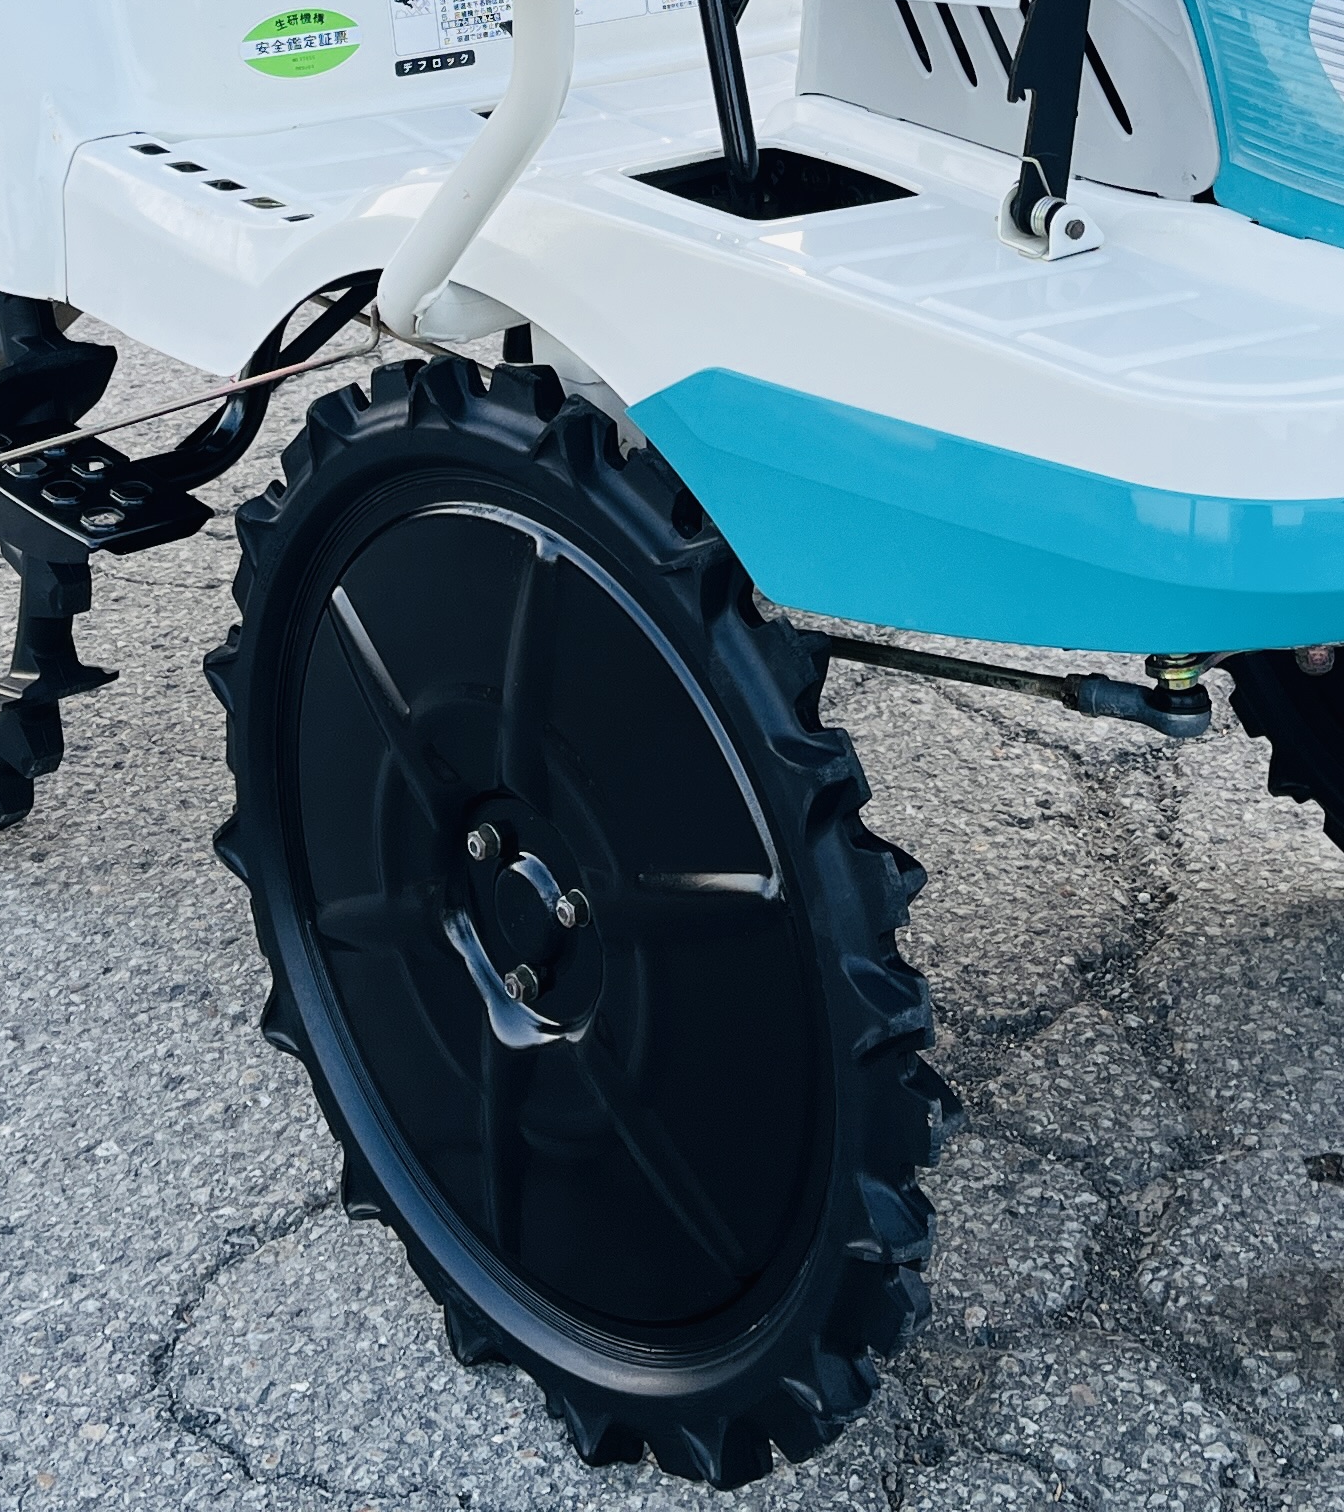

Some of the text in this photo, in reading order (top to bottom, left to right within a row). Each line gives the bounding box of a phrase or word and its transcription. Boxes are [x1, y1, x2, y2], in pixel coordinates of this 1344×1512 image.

[275, 12, 325, 31] 生研機構
[255, 30, 349, 55] 安全鑑定証票
[403, 53, 469, 73] デフロック
